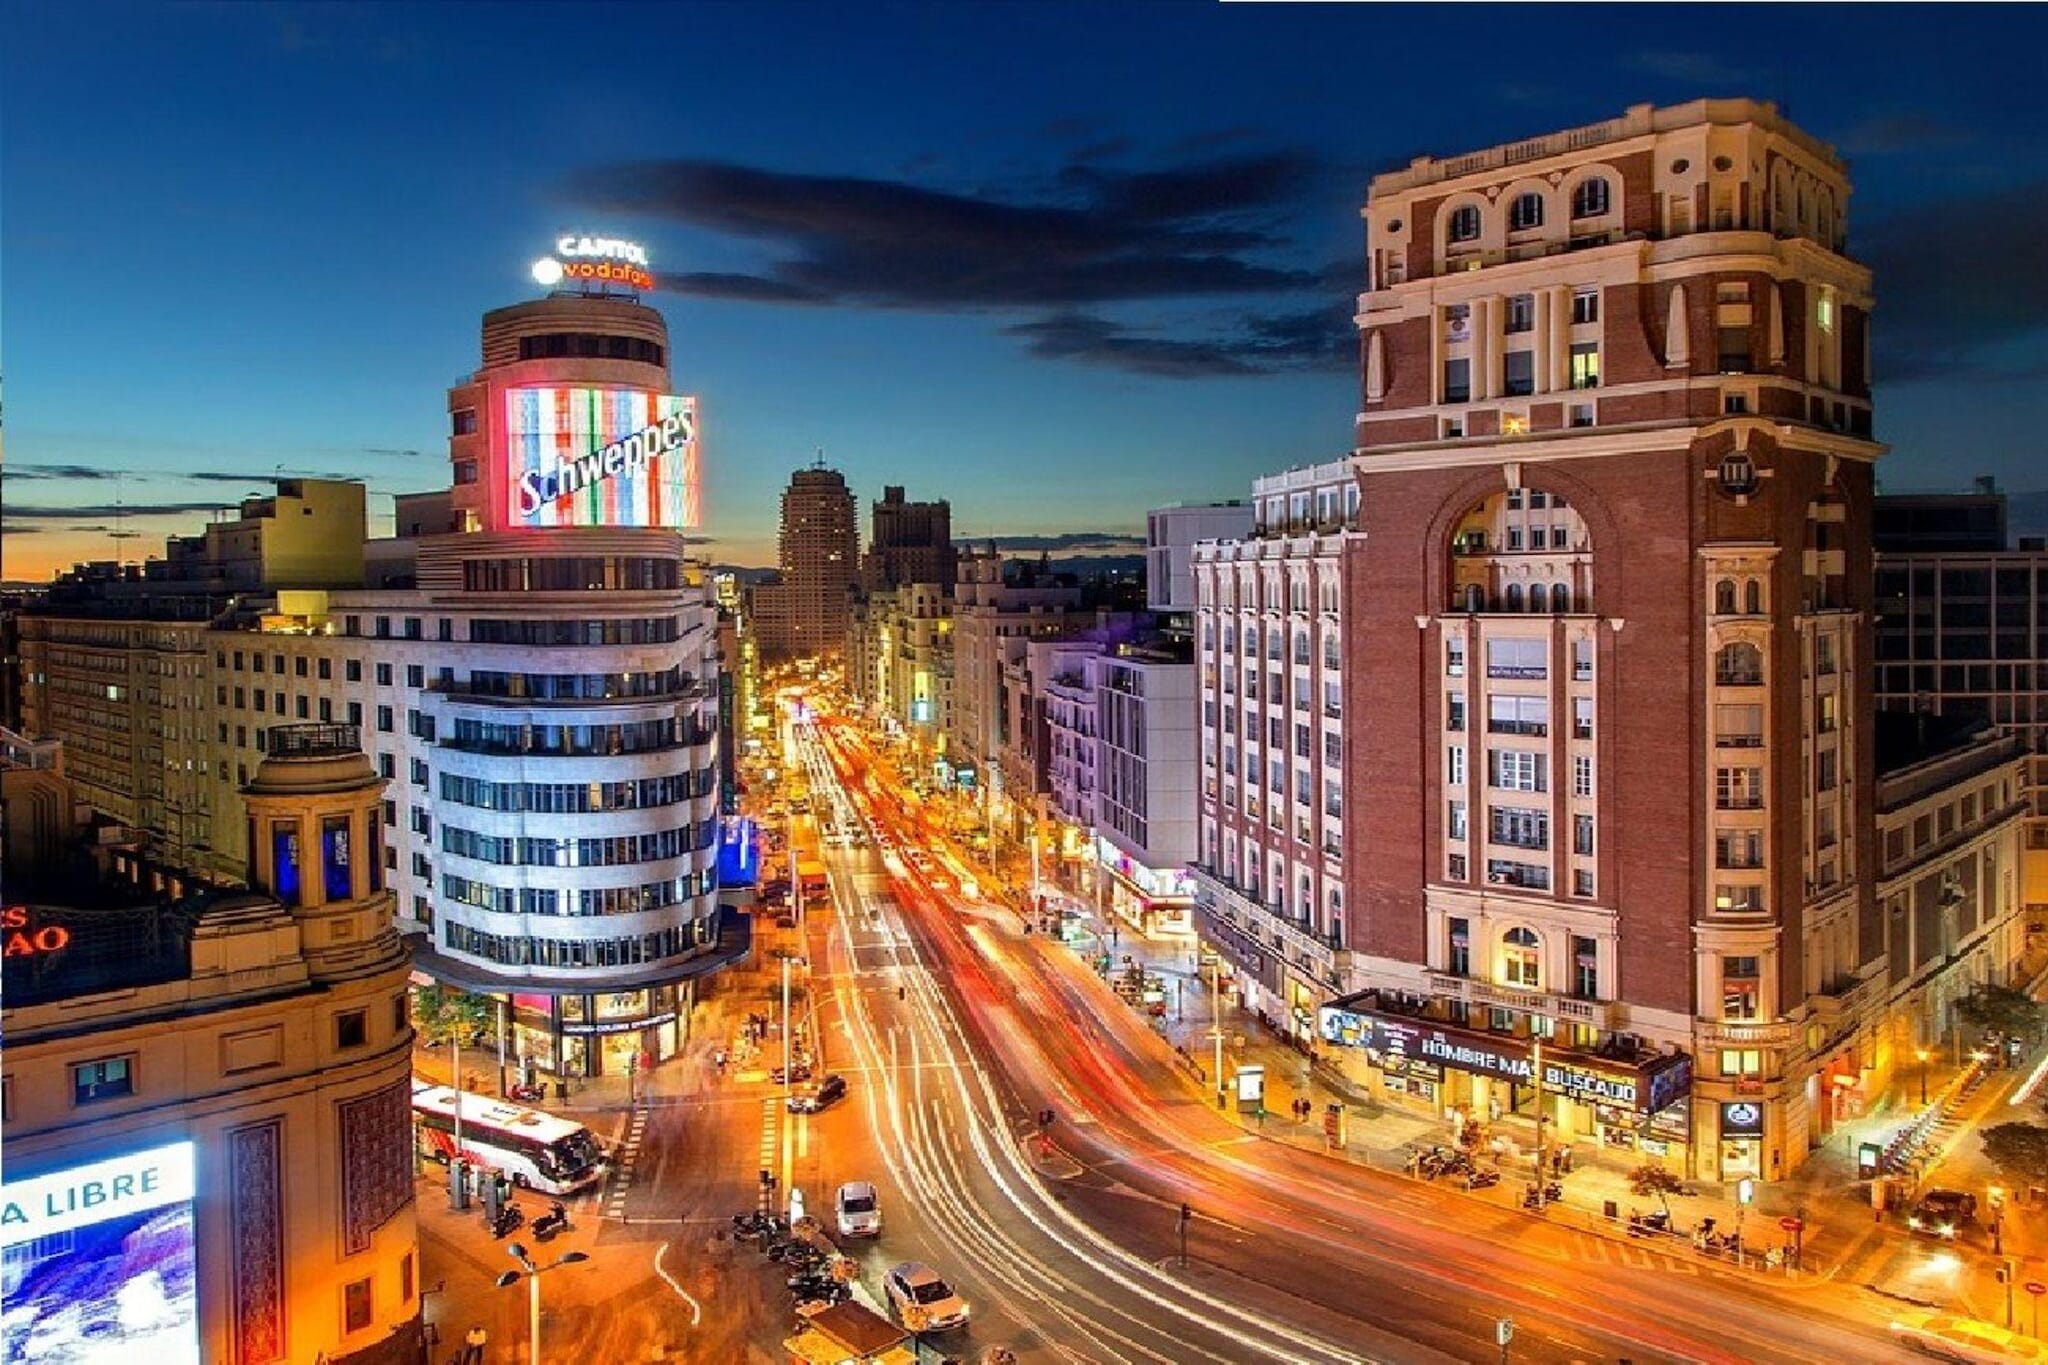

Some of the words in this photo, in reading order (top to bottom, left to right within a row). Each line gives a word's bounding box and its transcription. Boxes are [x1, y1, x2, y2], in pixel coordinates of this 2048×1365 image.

[520, 408, 695, 518] Schweppes
[1422, 1039, 1496, 1069] HOMBRE
[1546, 1067, 1636, 1101] BUSCADO
[1, 1202, 29, 1225] A
[47, 1166, 160, 1217] LIBRE
